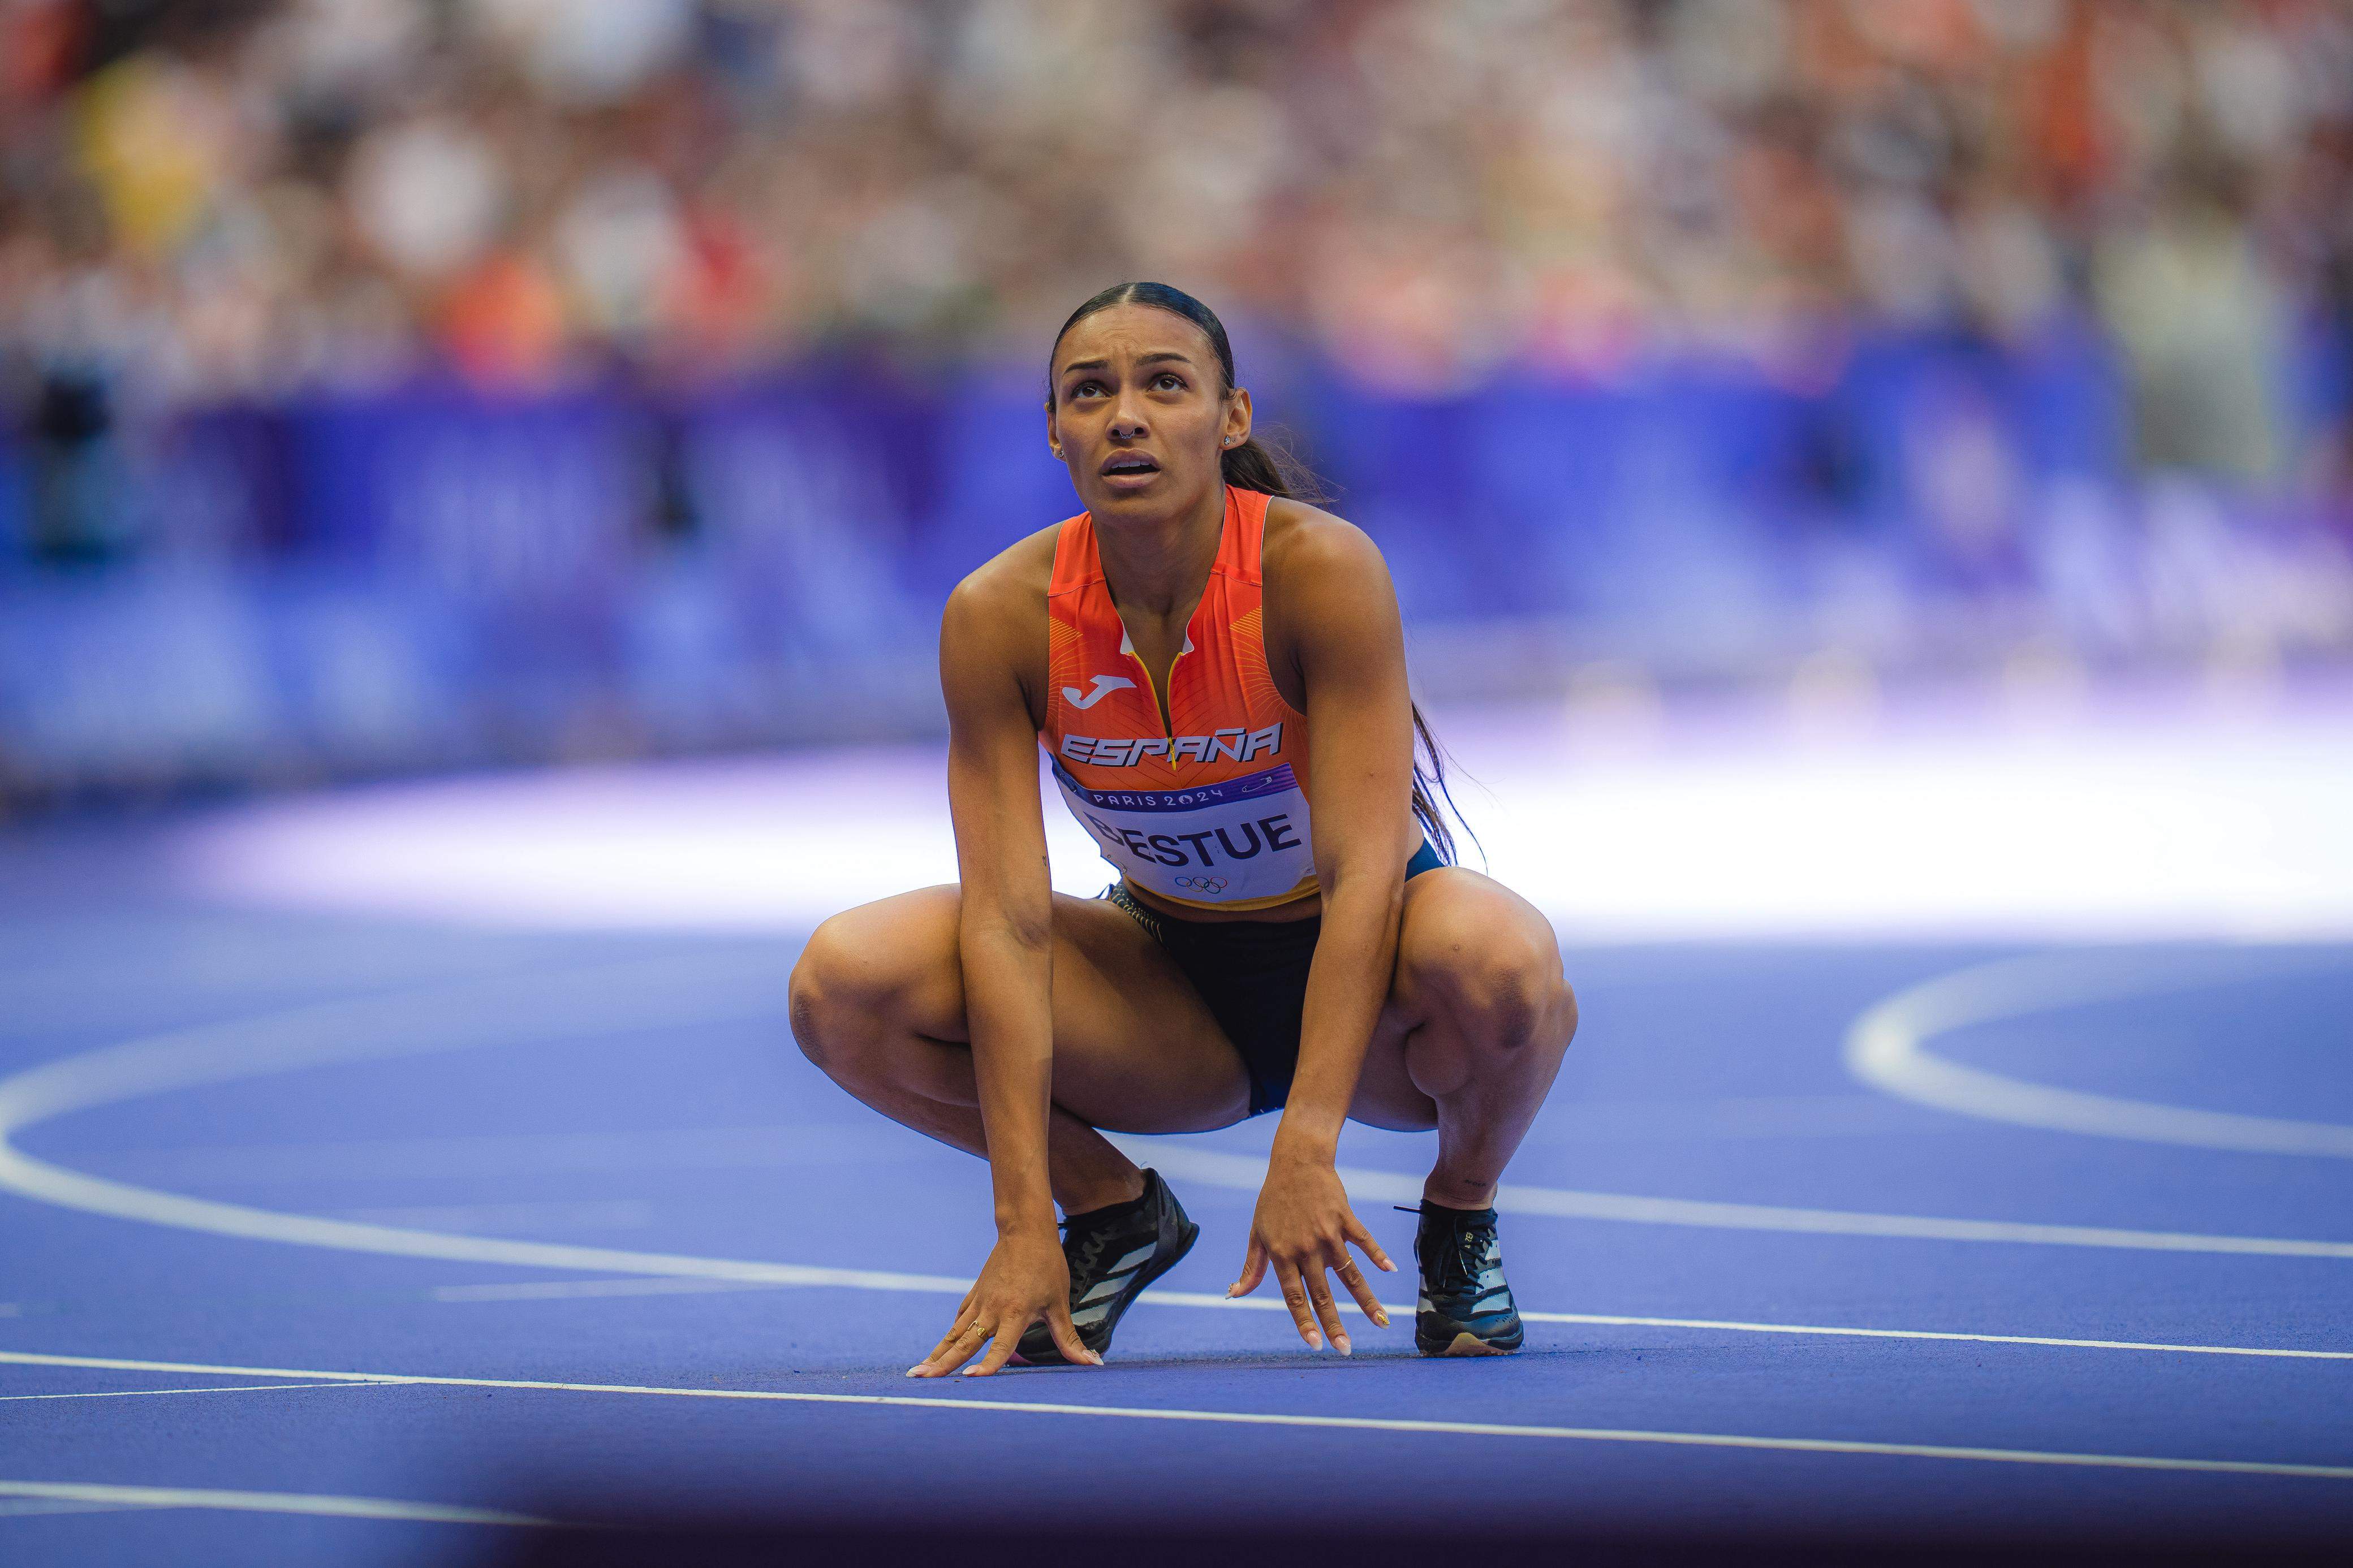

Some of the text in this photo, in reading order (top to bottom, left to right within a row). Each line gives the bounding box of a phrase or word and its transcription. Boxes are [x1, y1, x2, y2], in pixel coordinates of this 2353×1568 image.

[1061, 722, 1283, 767] ESPAÑA
[1093, 788, 1223, 806] PARIS 2024
[1083, 812, 1302, 867] BESTUE
